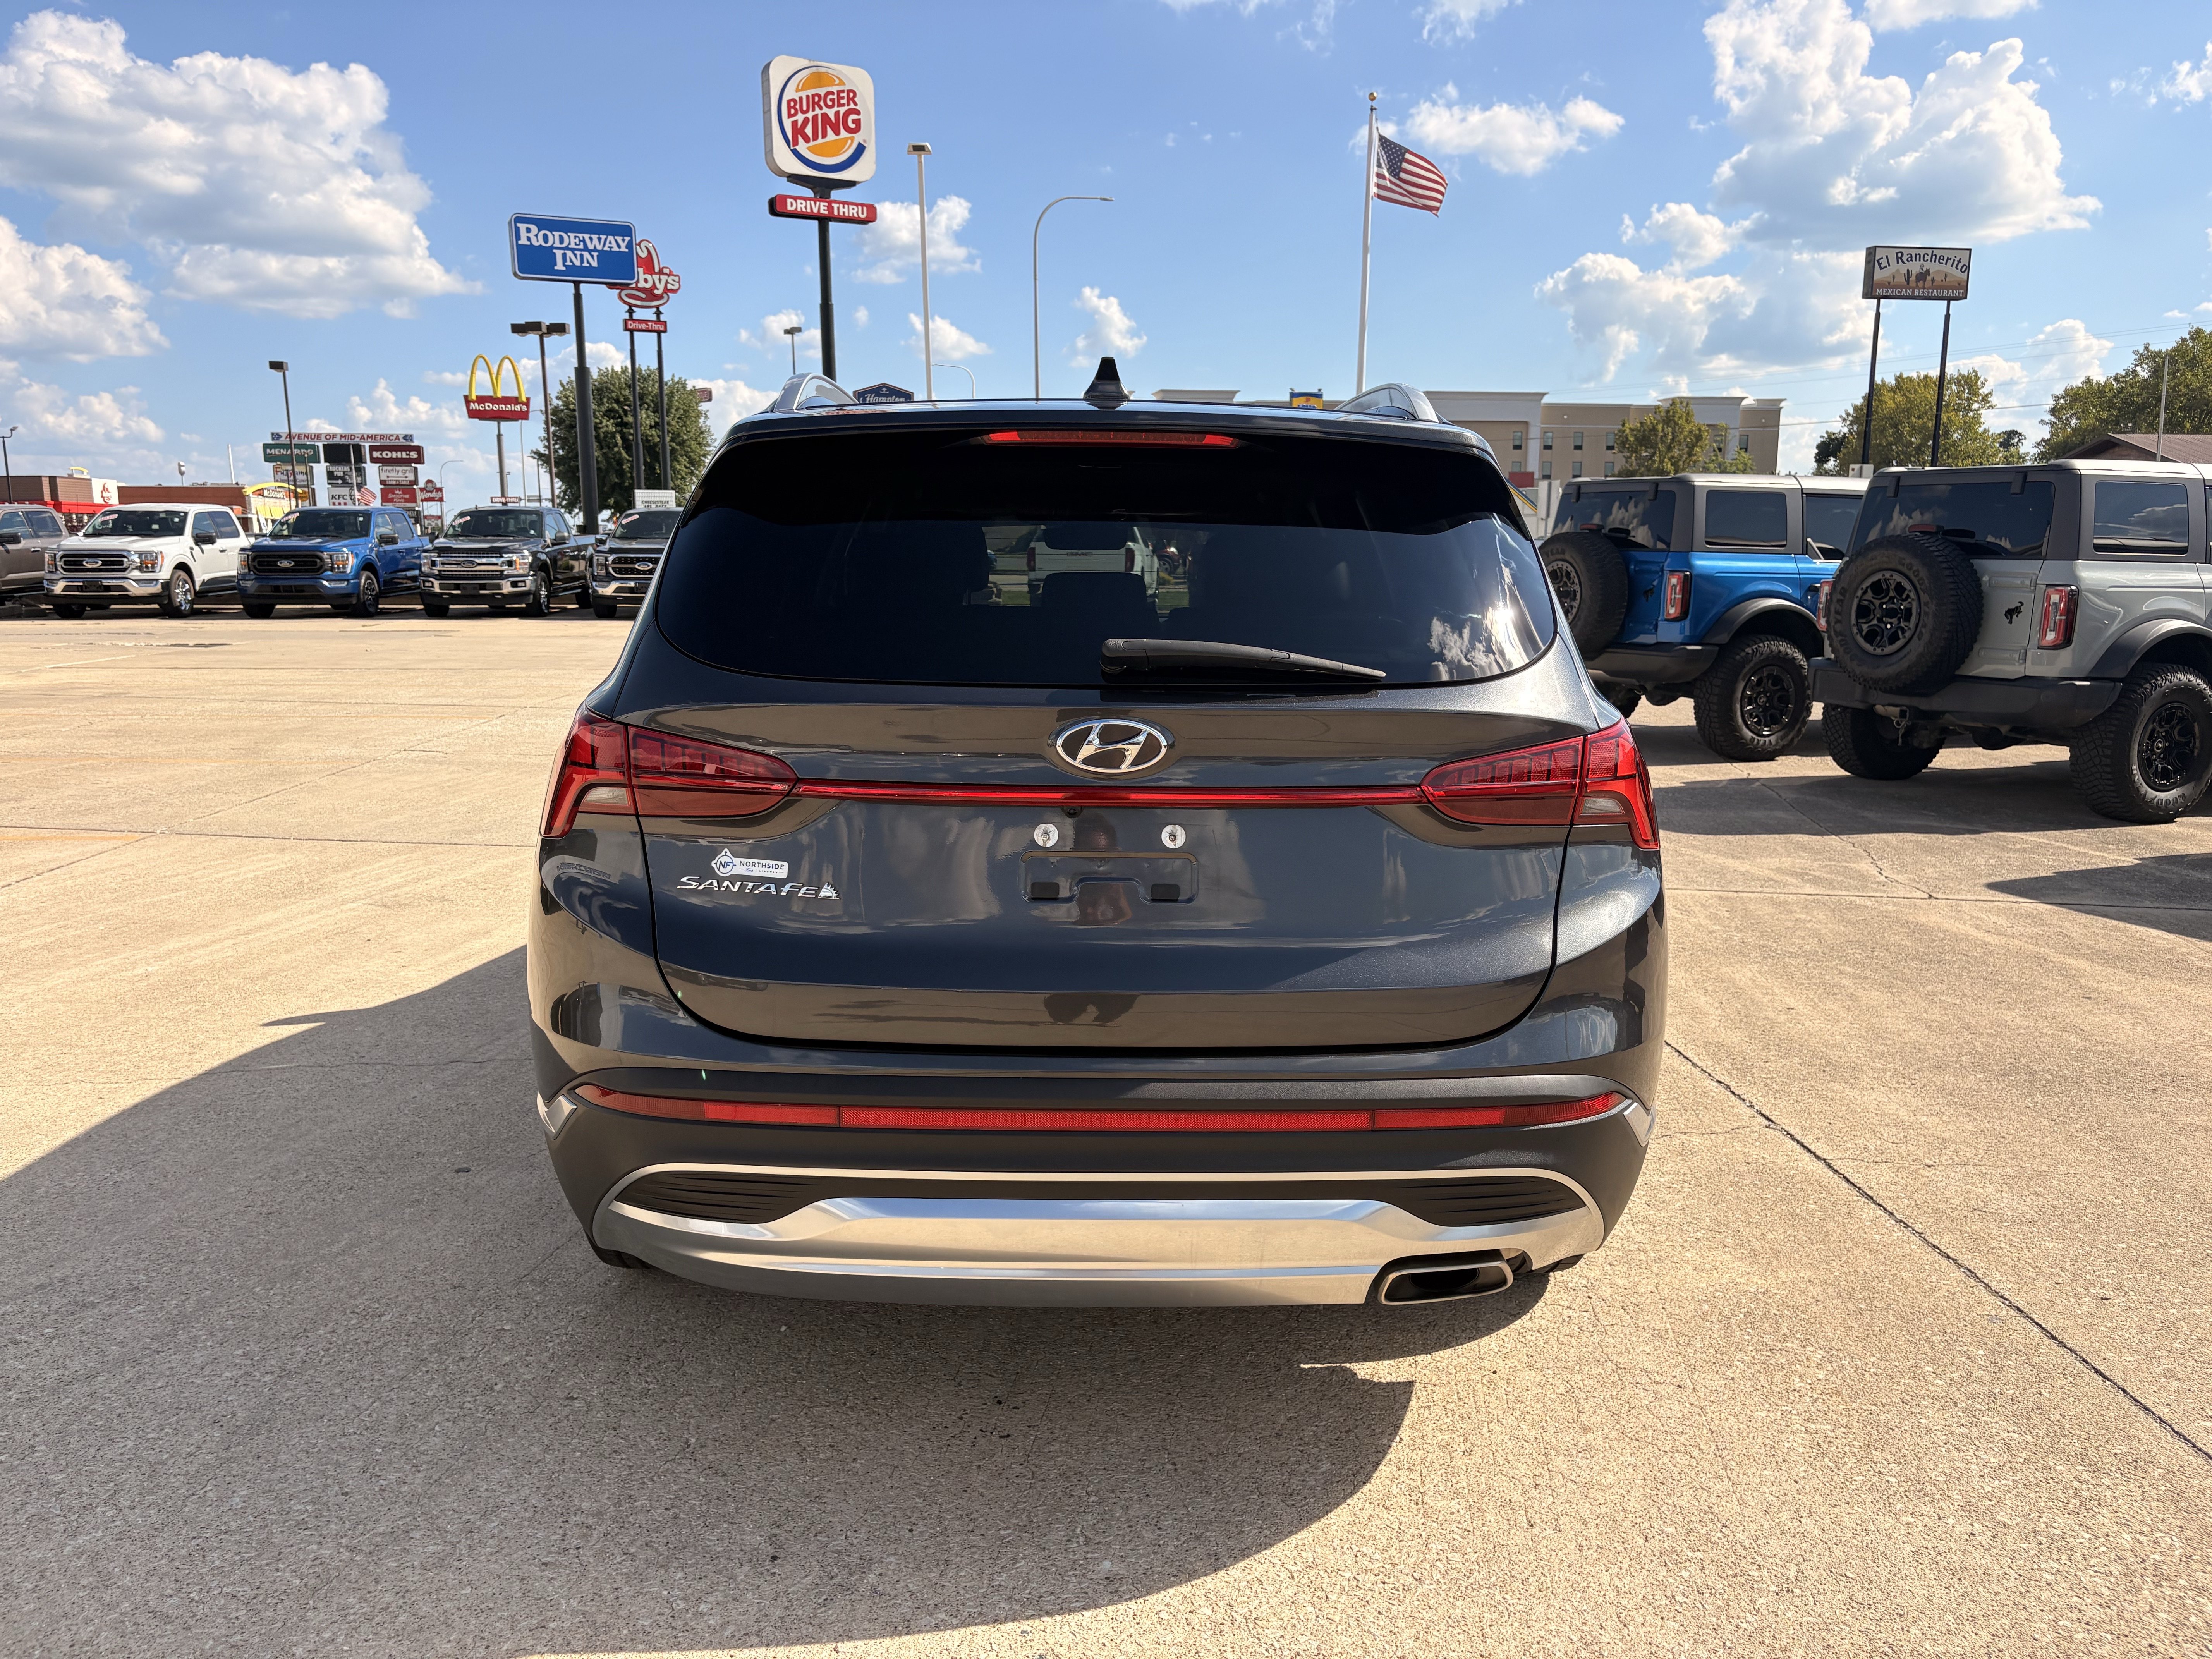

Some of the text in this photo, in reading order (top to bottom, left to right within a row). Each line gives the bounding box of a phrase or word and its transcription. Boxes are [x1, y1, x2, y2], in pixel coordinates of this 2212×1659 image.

[787, 89, 858, 119] BURGER
[792, 108, 862, 148] KING
[787, 198, 867, 218] DRIVE THRU
[517, 223, 631, 252] RODEWAY
[553, 249, 599, 270] INN
[1876, 250, 1968, 273] El Rancherito
[631, 267, 680, 295] by's
[1876, 288, 1964, 297] MEXICAN RESTAURANT
[628, 321, 665, 331] Drive-Thru
[864, 393, 905, 403] Hampton
[469, 402, 527, 412] McDonald's
[285, 433, 322, 441] AVENUE
[372, 450, 418, 459] KOHL'S
[381, 467, 414, 475] firefly grill
[420, 489, 443, 500] Wendy's
[739, 860, 785, 870] NORTHSIDE
